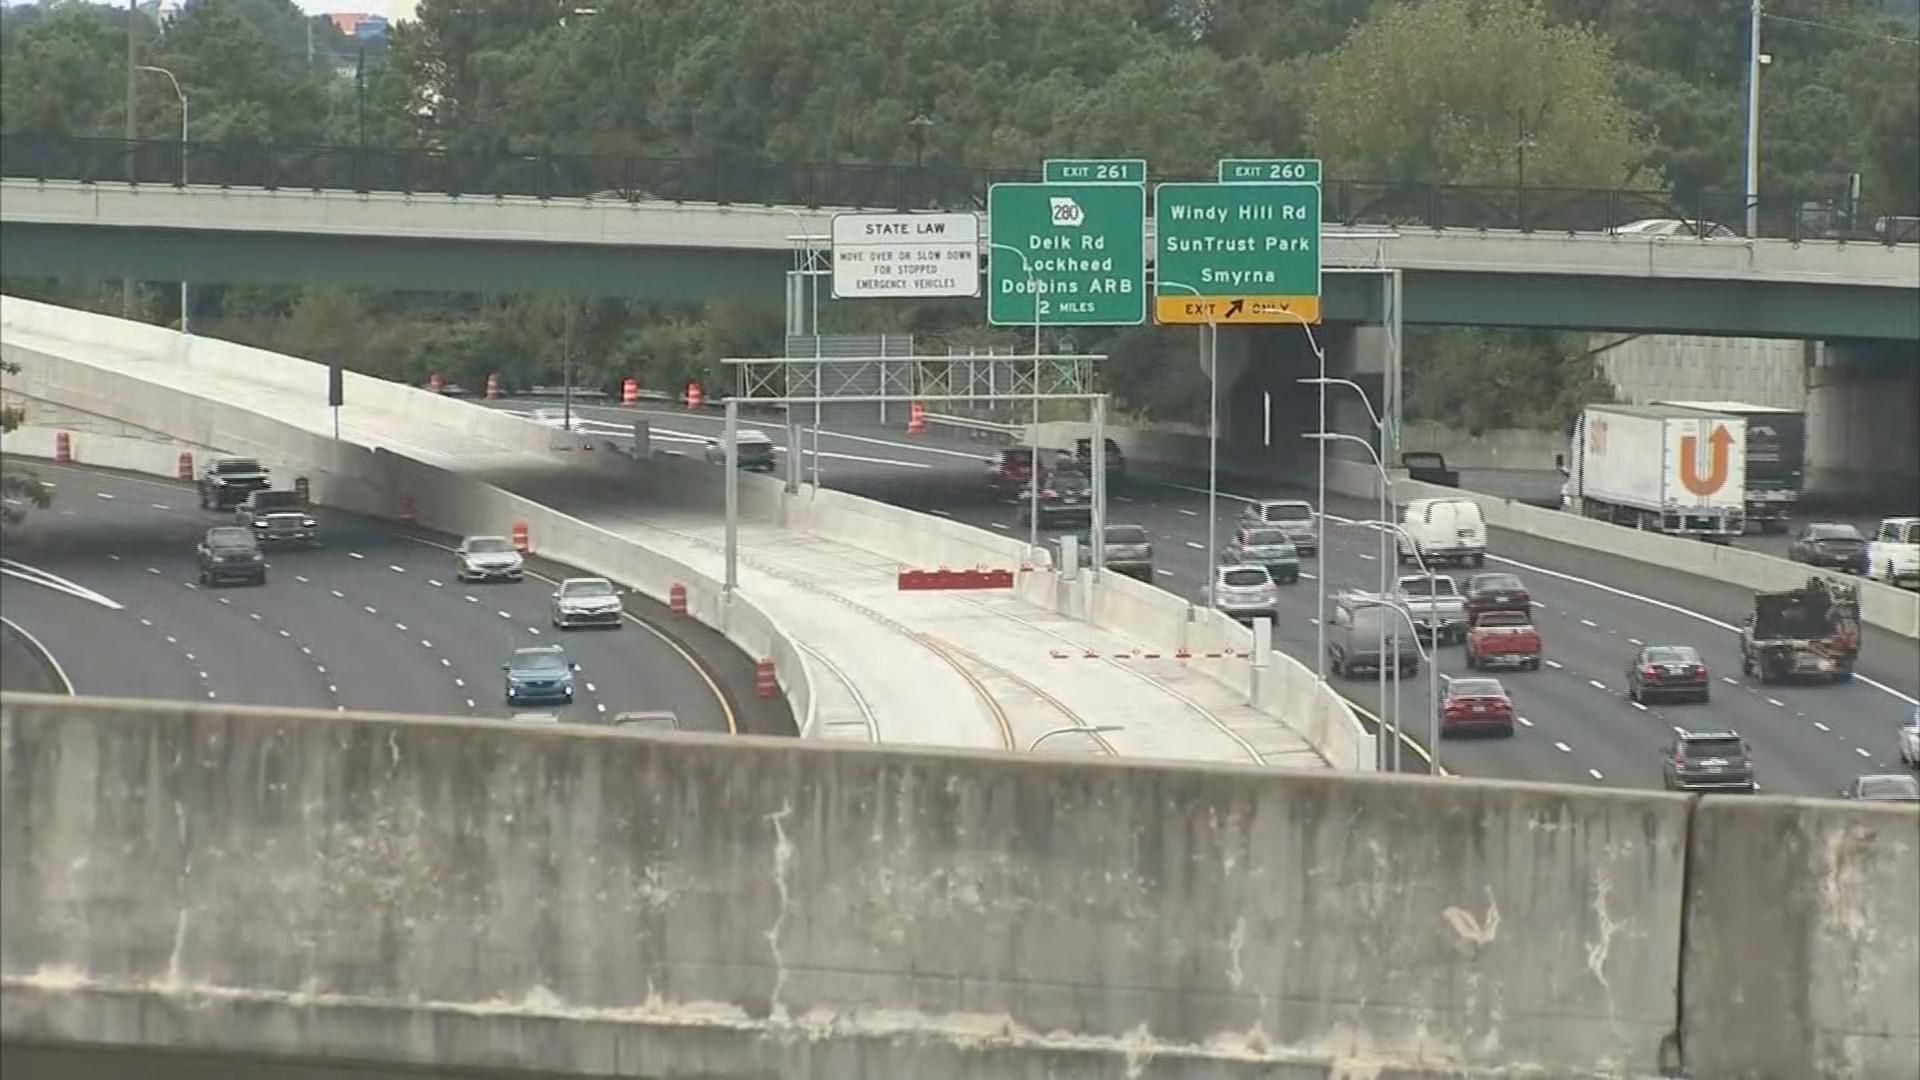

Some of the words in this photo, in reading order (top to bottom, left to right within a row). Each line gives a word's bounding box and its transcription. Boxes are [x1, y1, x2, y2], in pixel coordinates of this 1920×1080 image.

[1063, 167, 1089, 177] EXIT
[1096, 165, 1128, 179] 261
[1235, 166, 1262, 177] EXIT
[1269, 164, 1306, 179] 260
[1053, 204, 1079, 220] 280
[1170, 205, 1228, 223] Windy
[1239, 205, 1273, 220] Hill
[1282, 205, 1306, 220] Rd
[865, 223, 909, 235] STATE
[917, 223, 945, 234] LAW
[1029, 235, 1071, 250] Delk
[1081, 235, 1105, 250] Rd
[1166, 236, 1255, 252] SunTrust
[1265, 236, 1310, 251] Park
[840, 251, 863, 261] MOVE
[869, 251, 893, 260] OVER
[898, 251, 911, 260] OR
[917, 251, 941, 260] SLOW
[947, 251, 972, 260] DOWN
[874, 265, 891, 275] FOR
[898, 265, 938, 274] STOPPED
[1023, 257, 1113, 272] Lockheed
[856, 279, 907, 289] EMERGENCY
[914, 279, 955, 289] VEHICLES
[1201, 268, 1275, 286] Smyrna
[1002, 279, 1079, 294] Dobbins
[1089, 279, 1132, 294] ARB
[1039, 300, 1050, 314] 2
[1059, 302, 1096, 313] MILES
[1185, 303, 1216, 315] EXIT
